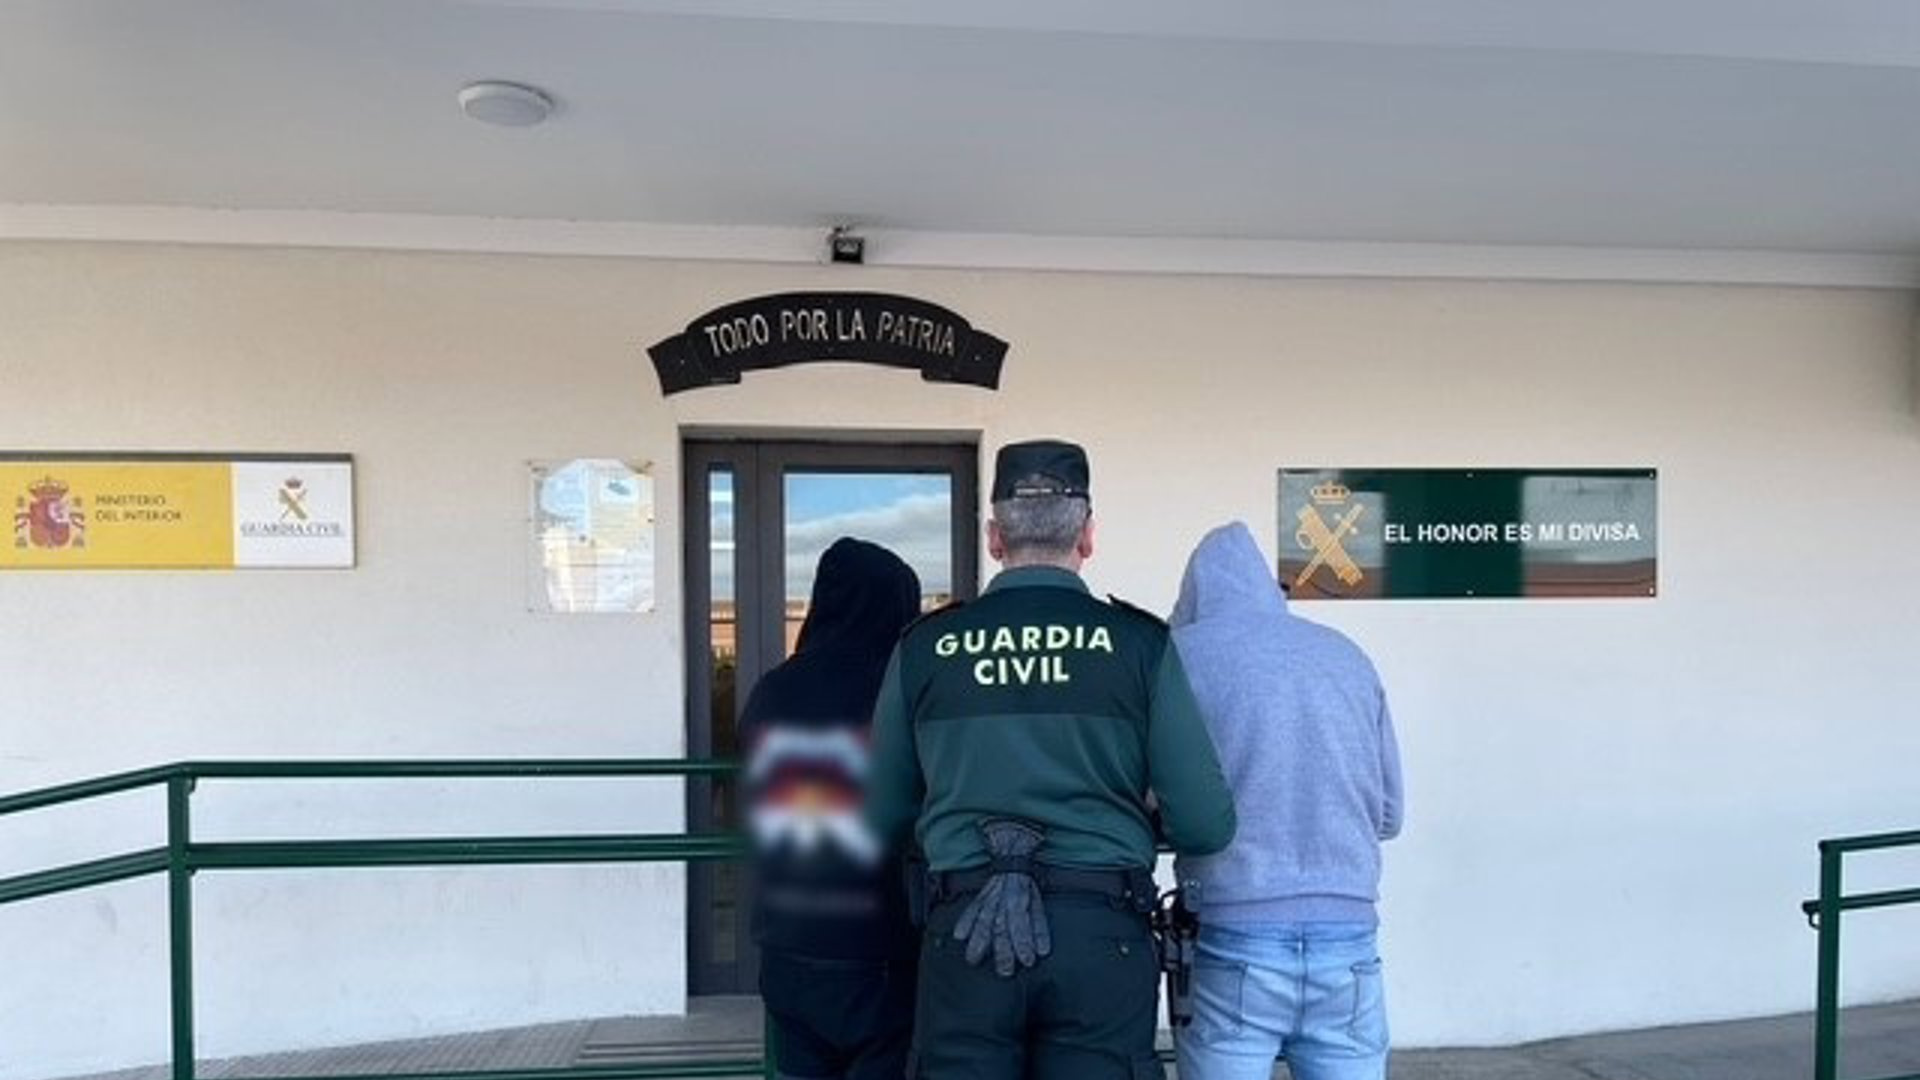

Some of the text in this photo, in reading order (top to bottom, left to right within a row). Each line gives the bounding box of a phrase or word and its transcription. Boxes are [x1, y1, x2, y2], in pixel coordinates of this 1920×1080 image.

[704, 309, 955, 357] TODO POR LA PATRIA
[95, 510, 182, 522] DEL INTERIOR
[240, 522, 344, 537] GUARDIA CIVIL
[1384, 522, 1641, 543] EL HONOR ES MI DIVISA
[935, 626, 1114, 656] GUARDIA
[974, 656, 1070, 685] CIVIL
